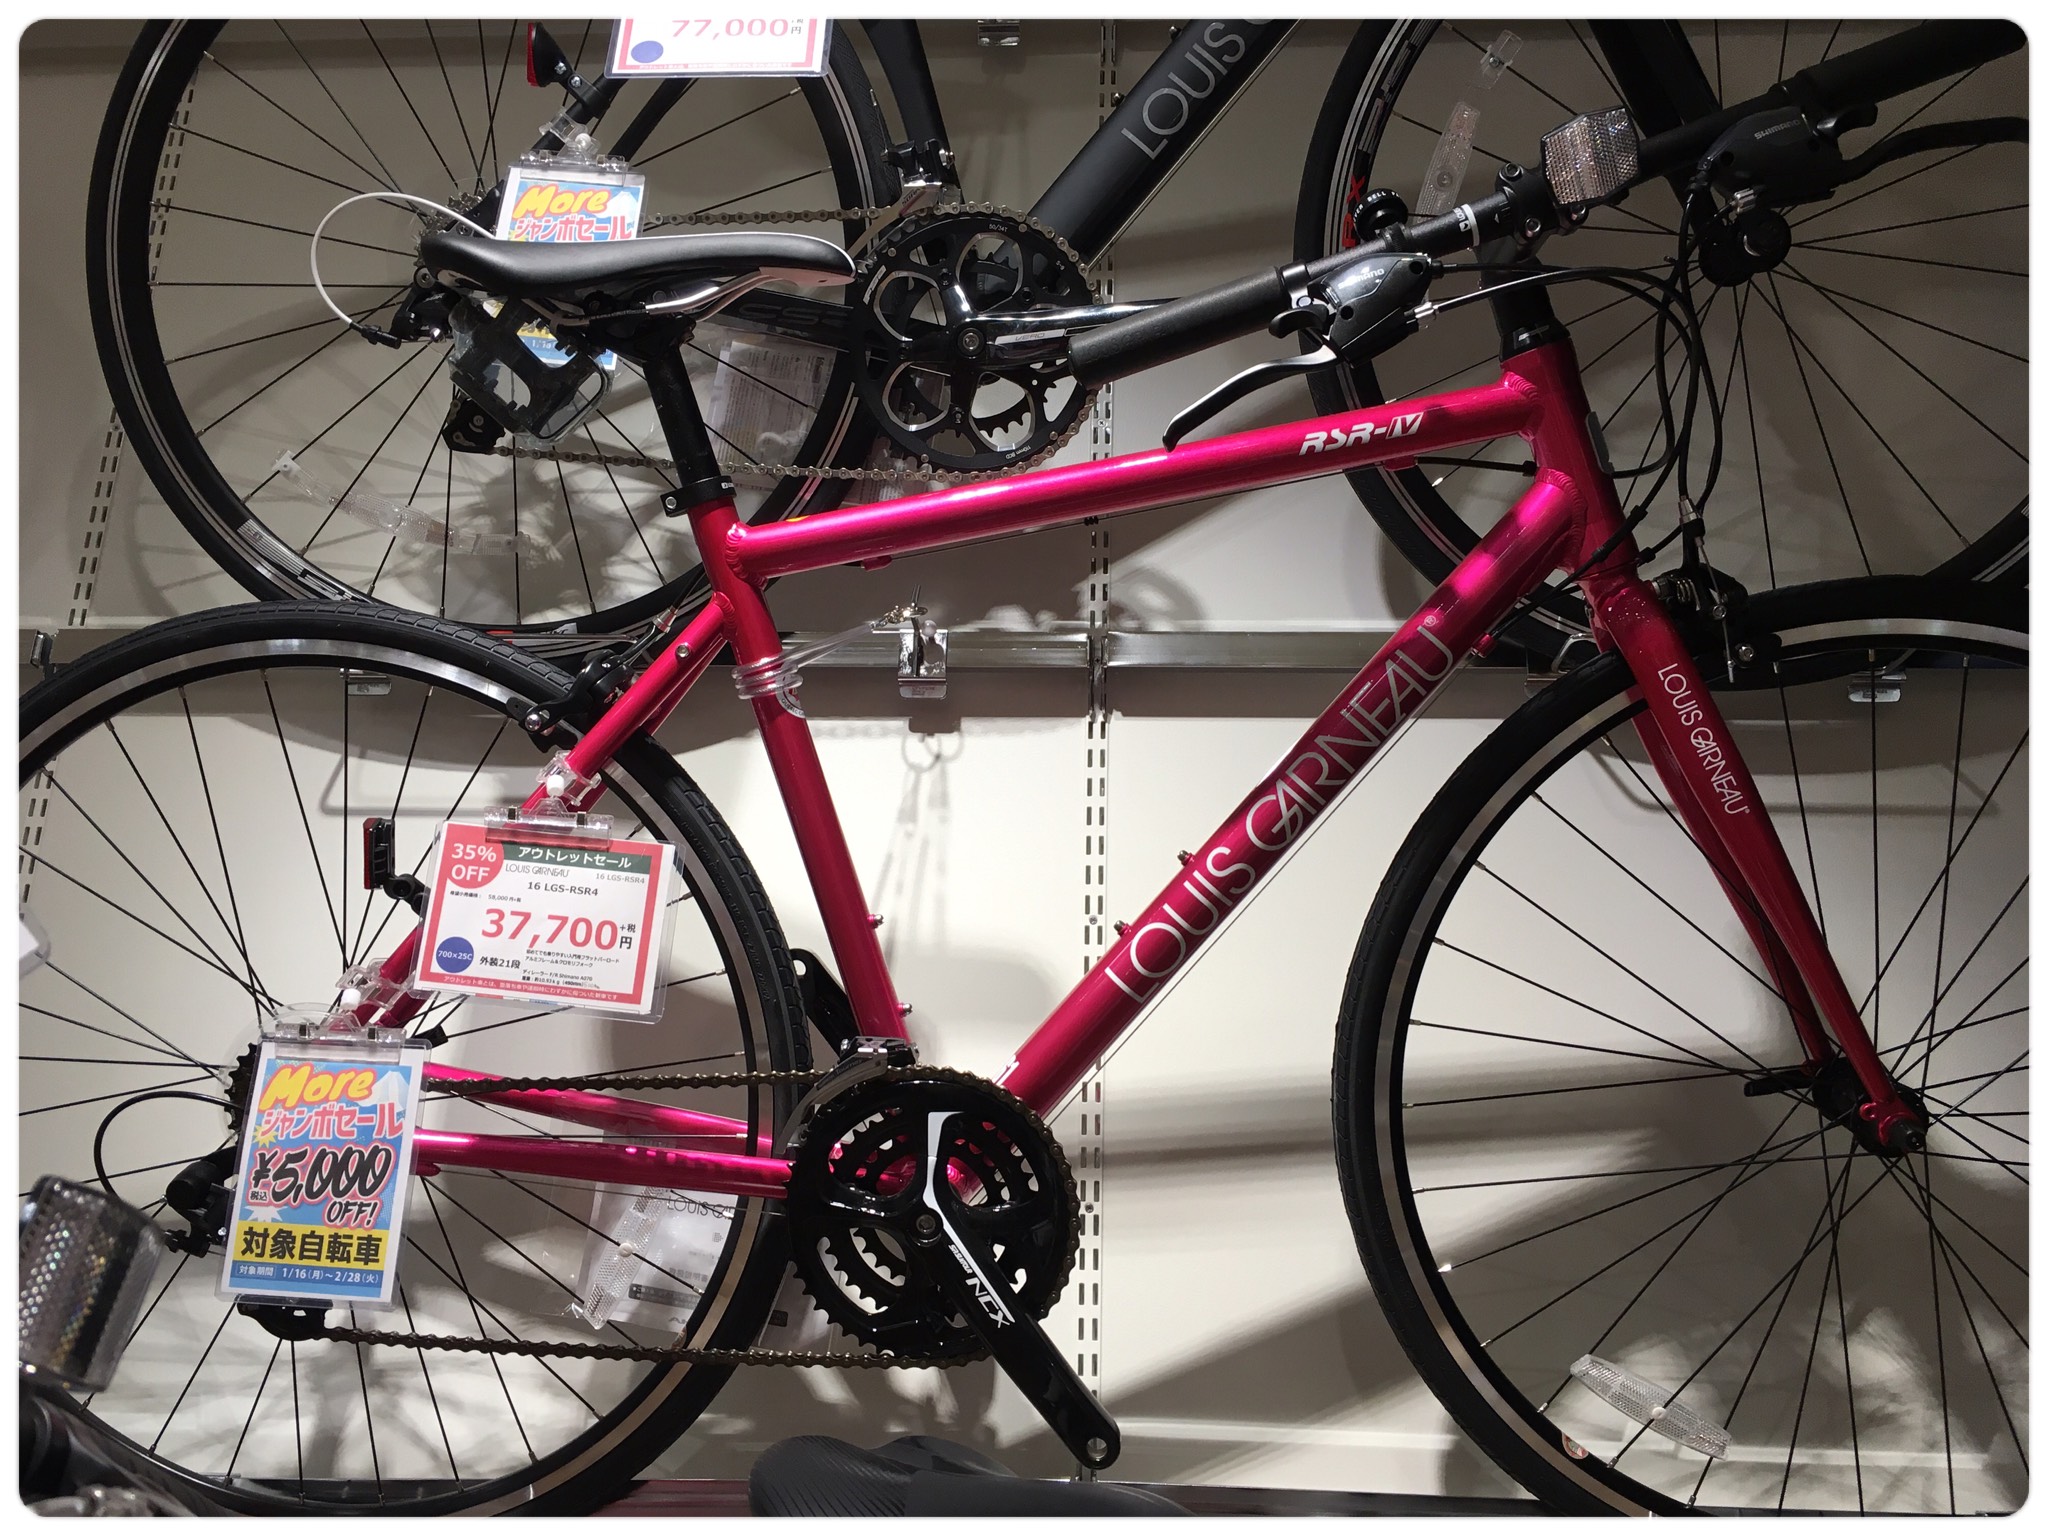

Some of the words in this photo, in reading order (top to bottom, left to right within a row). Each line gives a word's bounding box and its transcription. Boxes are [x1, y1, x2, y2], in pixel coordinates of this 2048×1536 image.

[672, 19, 789, 40] 77,000
[1120, 21, 1246, 160] LOUIS
[1754, 119, 1801, 140] SHIMANO
[512, 184, 610, 219] More
[514, 214, 633, 241] ジャンボセール
[1337, 268, 1385, 290] SMANO
[1657, 663, 1703, 726] LOUIS
[1690, 727, 1749, 815] GARNEAU
[1104, 846, 1256, 1003] LOUIS
[1246, 625, 1454, 851] GARNEAU
[451, 843, 497, 863] 35%
[518, 846, 632, 868] アウトレットセール
[451, 863, 491, 882] OFF
[505, 864, 531, 874] LOUIS
[532, 867, 570, 877] GARNEAU
[596, 873, 606, 881] 16
[607, 874, 645, 884] LGS-RSR4
[527, 881, 541, 890] 16
[544, 883, 599, 897] LGS-RSR4
[481, 908, 619, 950] 37,700
[619, 936, 633, 950] 円
[479, 956, 521, 969] 外装21段
[258, 1062, 377, 1112] More
[260, 1101, 404, 1139] ジャンボセール
[252, 1146, 392, 1203] ¥5,000
[250, 1190, 268, 1202] 税込
[326, 1200, 378, 1226] OFF!
[240, 1226, 383, 1266] 対象自転車
[238, 1264, 274, 1278] 対象期間
[965, 1277, 1010, 1329] NCX
